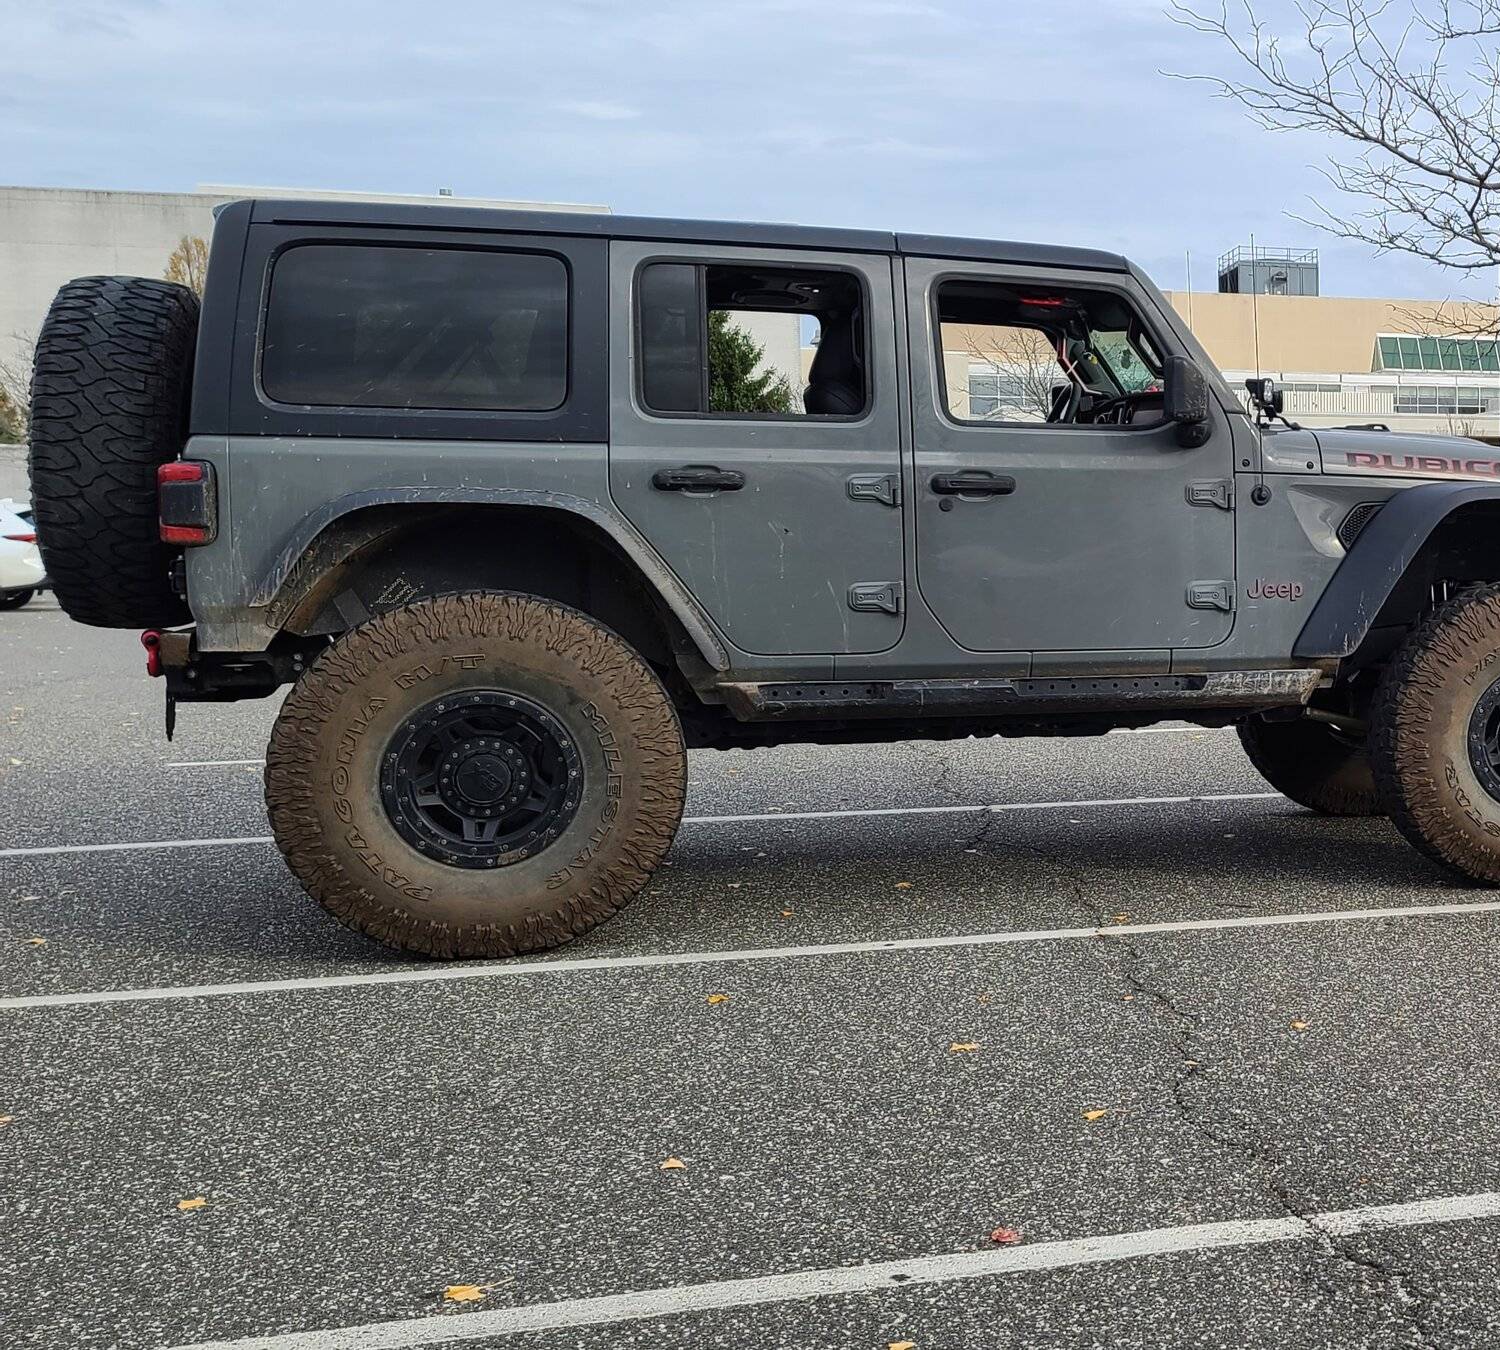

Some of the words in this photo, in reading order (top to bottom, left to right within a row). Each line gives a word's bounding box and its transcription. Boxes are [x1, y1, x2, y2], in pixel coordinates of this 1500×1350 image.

[1246, 578, 1303, 602] Jeep
[395, 653, 486, 690] M/T
[331, 697, 435, 901] PATAGONIA
[544, 700, 624, 890] MILESTAR
